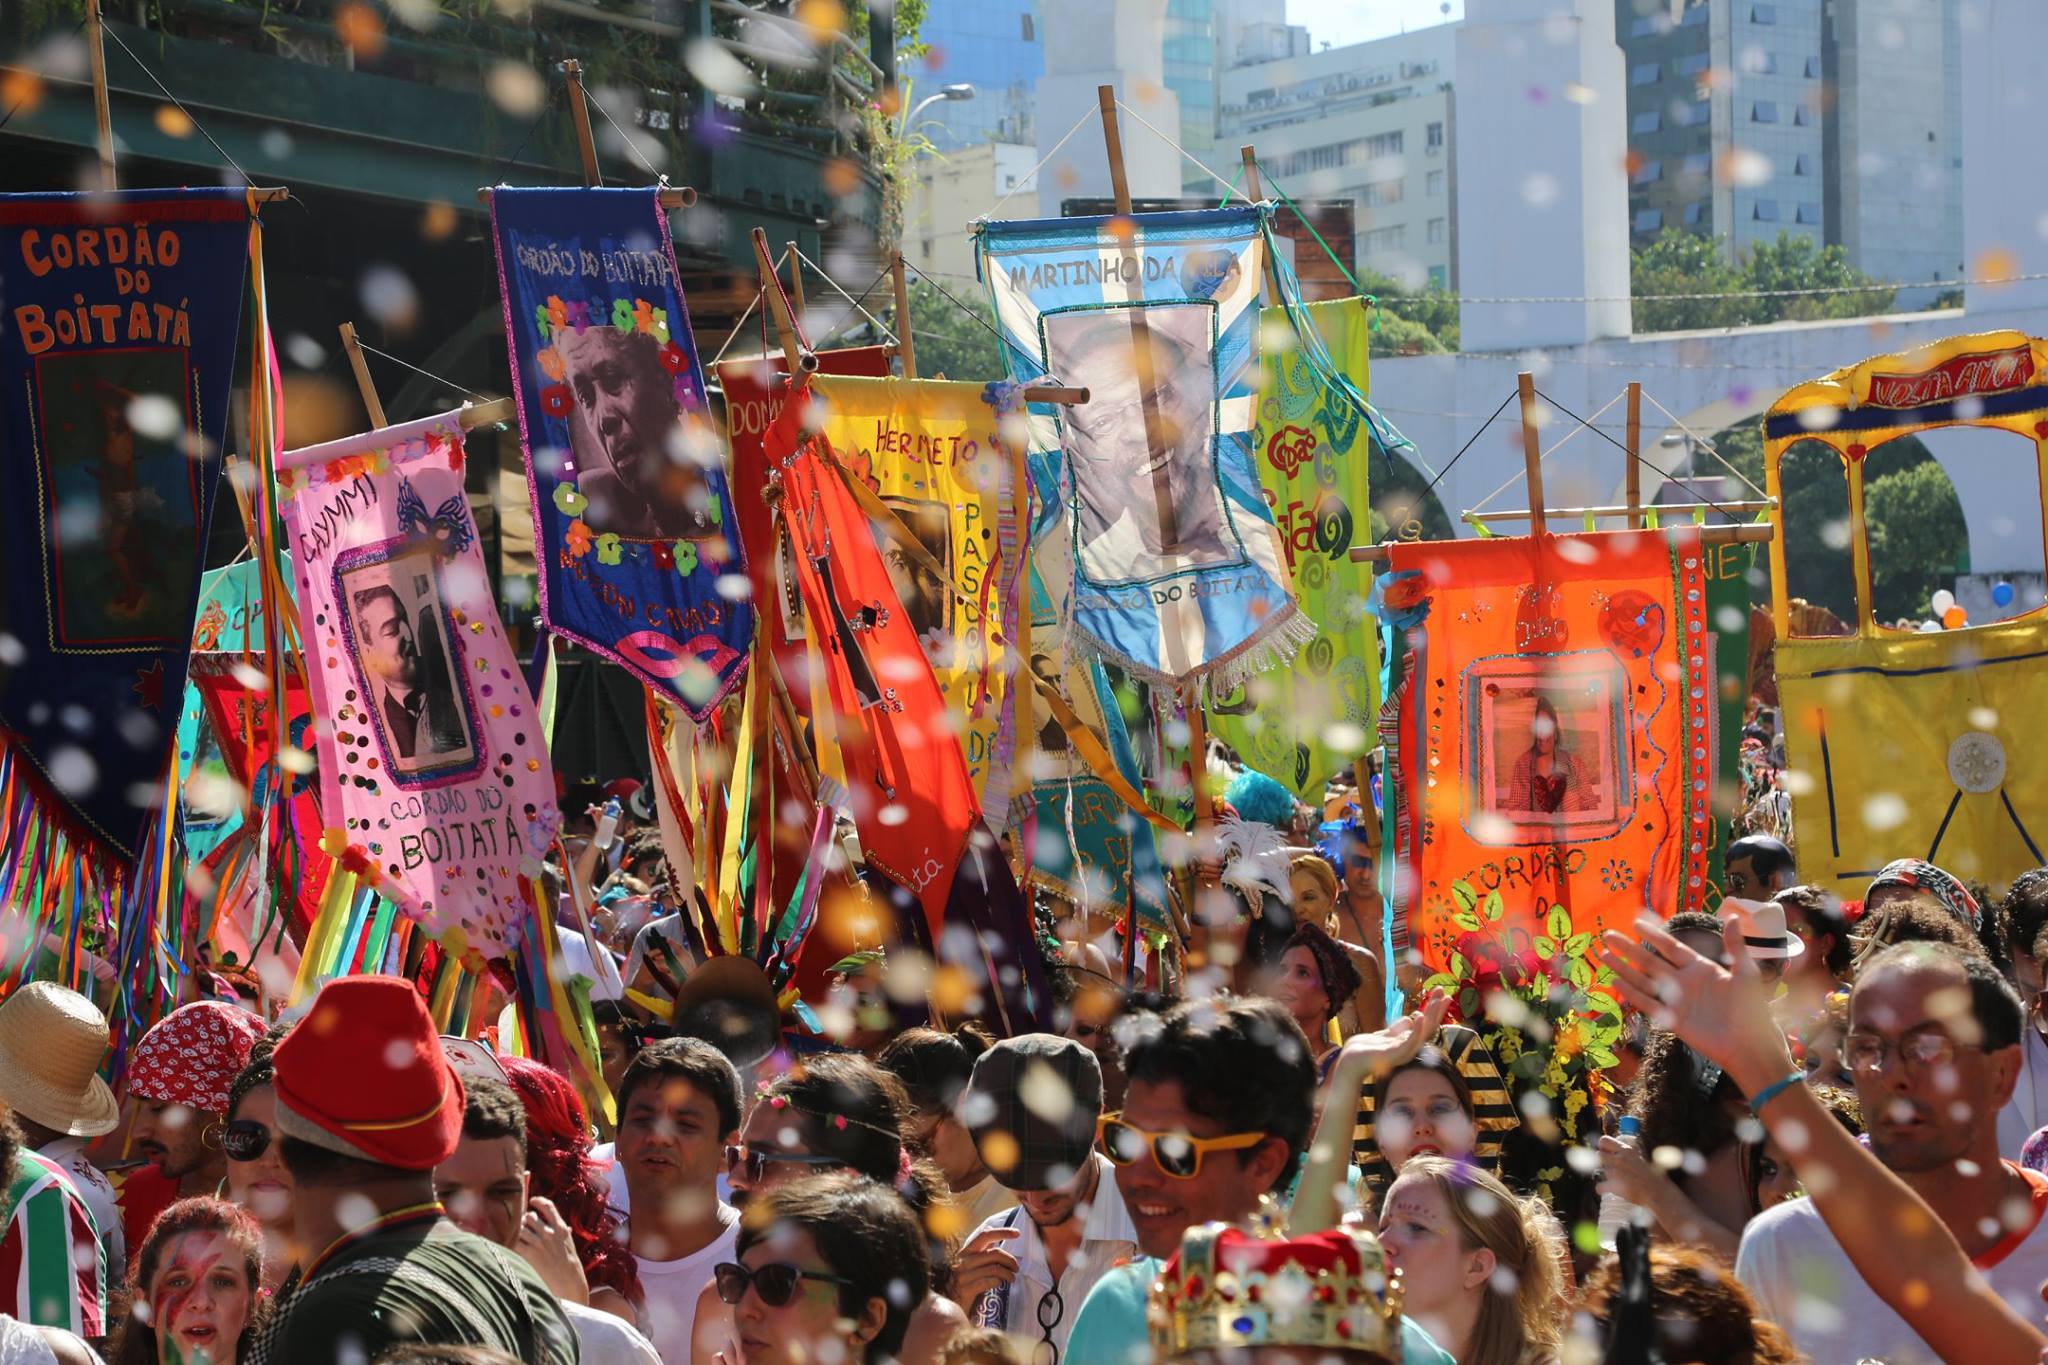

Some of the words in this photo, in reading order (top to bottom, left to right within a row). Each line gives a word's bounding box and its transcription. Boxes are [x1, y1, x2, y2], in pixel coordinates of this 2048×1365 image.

[20, 221, 181, 277] CORDÃO
[579, 249, 600, 278] DO
[115, 267, 151, 296] DO
[1010, 257, 1140, 292] MARTINHO
[1146, 257, 1176, 281] DA
[1876, 371, 1954, 405] VOLTA
[1954, 352, 2030, 392] AMOR
[876, 419, 979, 468] HERMETO
[300, 472, 377, 564] CAYMMI
[1153, 585, 1183, 605] DO
[390, 787, 468, 820] CORDÃO
[475, 785, 503, 811] DO
